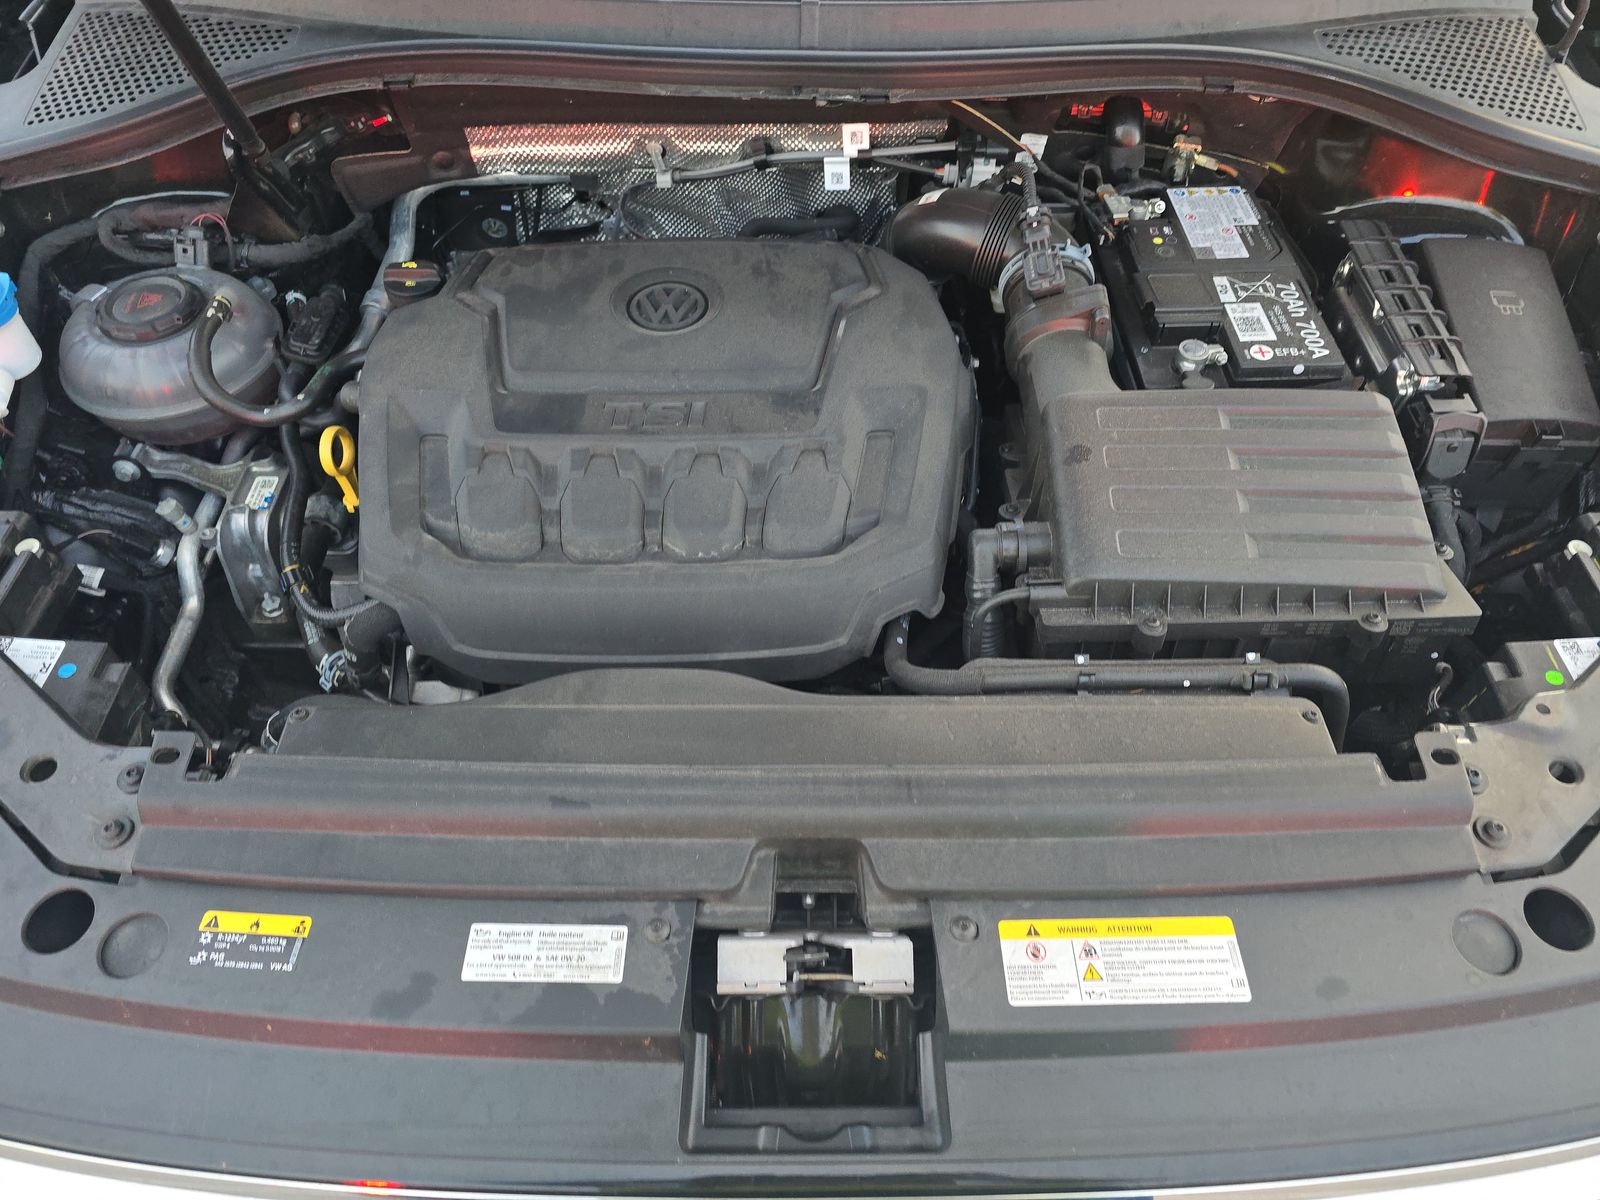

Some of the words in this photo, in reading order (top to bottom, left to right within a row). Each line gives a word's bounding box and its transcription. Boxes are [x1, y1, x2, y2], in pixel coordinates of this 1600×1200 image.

[1276, 281, 1308, 318] 70Ah
[1295, 320, 1330, 359] 700A
[602, 401, 708, 431] TSI
[498, 929, 521, 939] Engine
[523, 928, 534, 937] Oil
[538, 928, 556, 938] Huile
[558, 930, 584, 938] moteur
[1057, 925, 1098, 934] WARNING
[1107, 924, 1153, 933] ATTENTION
[492, 954, 506, 962] VW
[270, 962, 281, 971] VW
